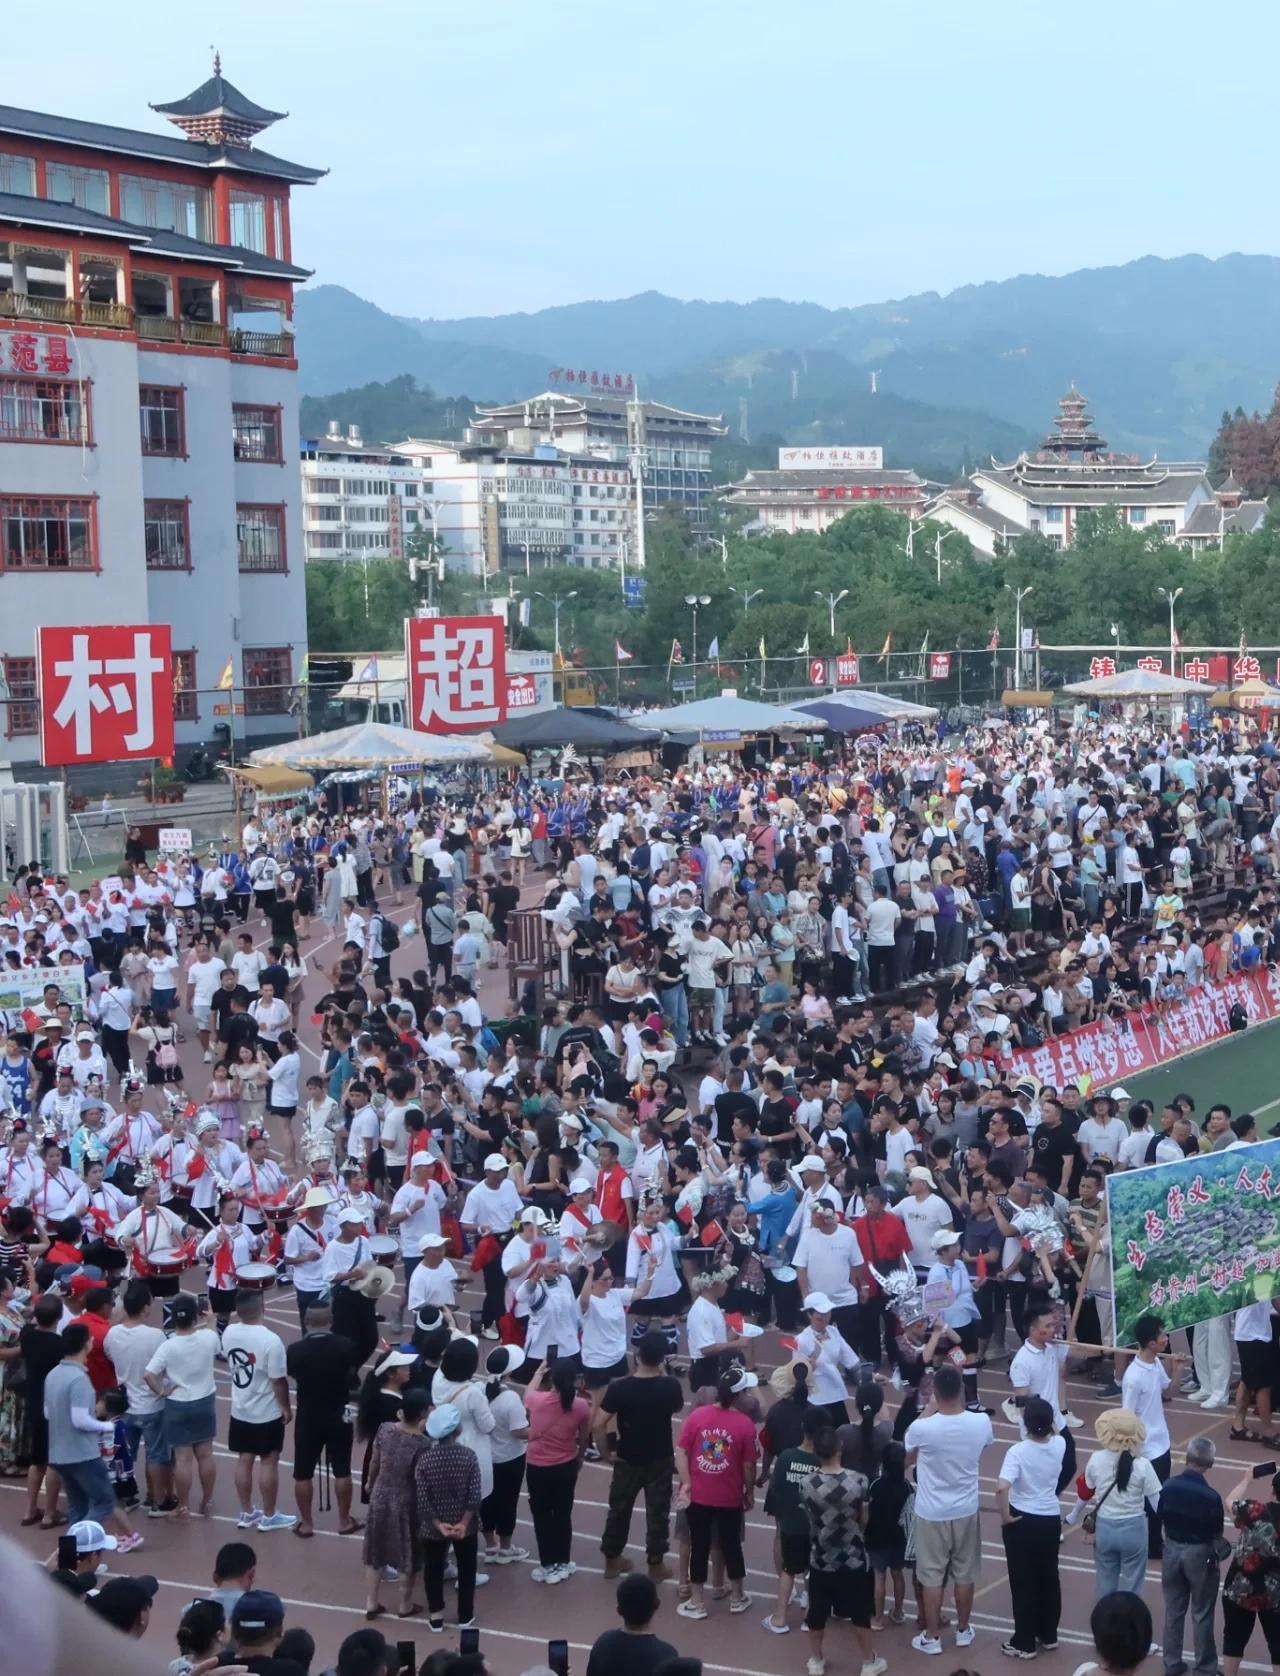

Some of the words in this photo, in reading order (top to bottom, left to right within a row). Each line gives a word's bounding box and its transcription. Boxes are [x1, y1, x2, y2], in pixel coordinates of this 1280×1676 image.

[0, 336, 72, 374] 范县
[418, 624, 500, 727] 超
[814, 662, 824, 684] 2
[54, 633, 164, 755] 村
[507, 687, 536, 706] 安全出口
